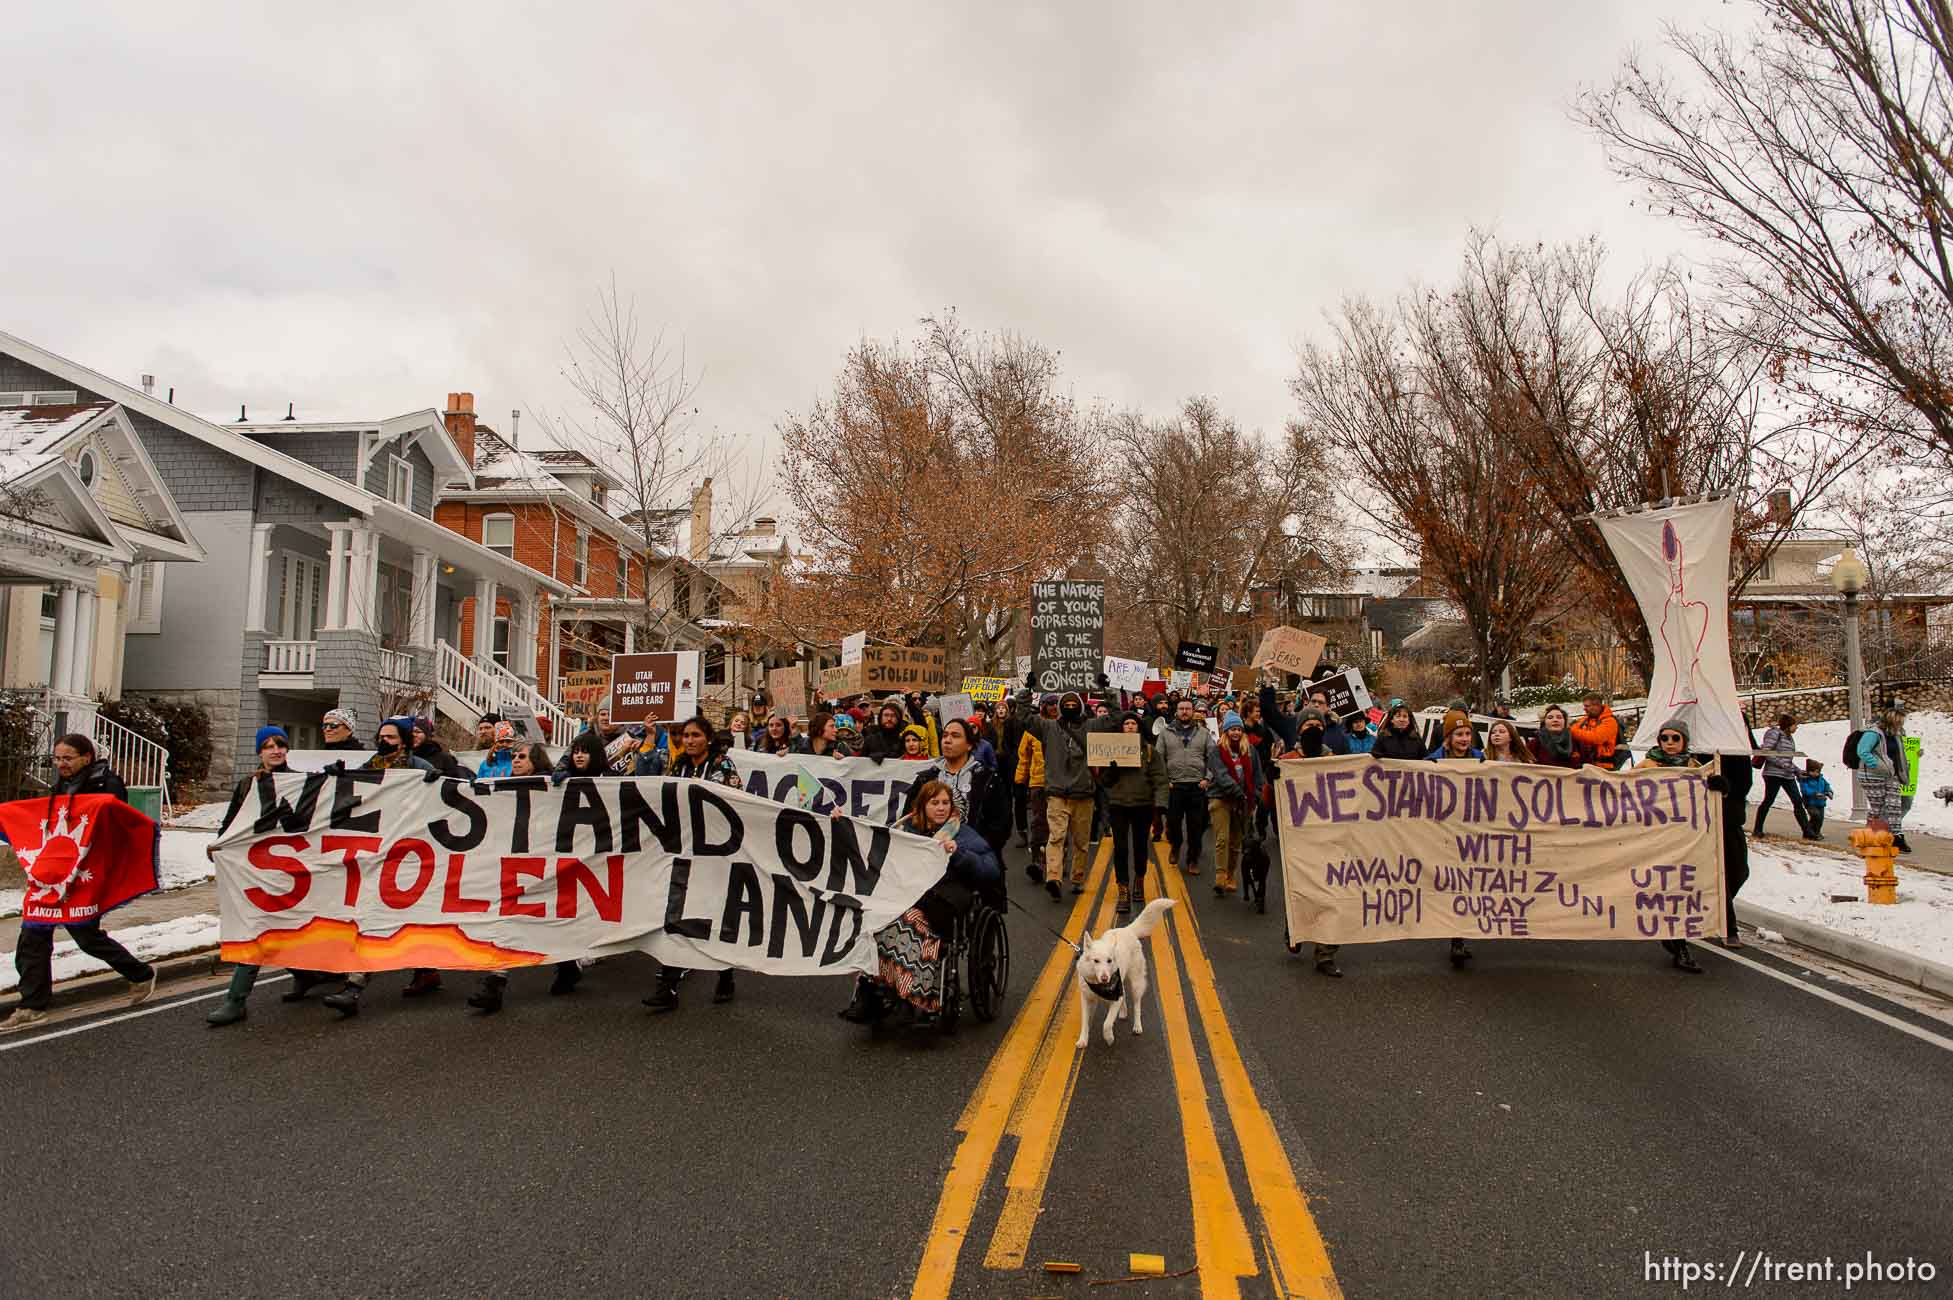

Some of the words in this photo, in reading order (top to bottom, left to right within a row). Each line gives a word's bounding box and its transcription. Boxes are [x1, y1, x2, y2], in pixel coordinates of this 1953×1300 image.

[1031, 582, 1057, 598] THE
[1060, 581, 1104, 601] NATURE
[1037, 600, 1057, 614] OF
[1063, 600, 1101, 615] YOUR
[1030, 614, 1103, 630] OPPRESSION
[1045, 631, 1057, 647] IS
[1065, 632, 1093, 646] THE
[864, 648, 885, 661] WE
[1037, 645, 1102, 661] AESTHETIC
[867, 664, 918, 682] STOLEN
[1049, 660, 1066, 671] OF
[1069, 660, 1094, 672] OUR
[1108, 660, 1129, 675] ARE
[635, 671, 653, 681] UTAH
[1039, 669, 1098, 692] ANGER
[580, 687, 604, 704] OFF
[616, 682, 649, 694] STANDS
[651, 682, 671, 693] WITH
[973, 692, 1001, 701] ANDS!
[1337, 689, 1350, 701] WITH
[622, 696, 644, 705] BEARS
[645, 695, 664, 705] EARS
[1284, 771, 1359, 827] WE
[1361, 764, 1458, 823] STAND
[1463, 777, 1499, 824] IN
[252, 768, 385, 834] WE
[428, 774, 746, 857] STAND
[775, 807, 892, 896] ON
[1456, 833, 1532, 866] WITH
[243, 833, 625, 922] STOLEN
[1326, 857, 1422, 888] NAVAJO
[1434, 864, 1528, 894] UINTAH
[1631, 864, 1697, 893] UTE
[27, 905, 63, 918] LAKOTA
[69, 904, 98, 918] NATION
[663, 856, 864, 968] LAND
[1361, 888, 1422, 927] HOPI
[1452, 895, 1538, 918] OURAY
[1636, 891, 1708, 916] MTN.
[1478, 918, 1530, 936] UTE
[1636, 914, 1704, 938] UTE
